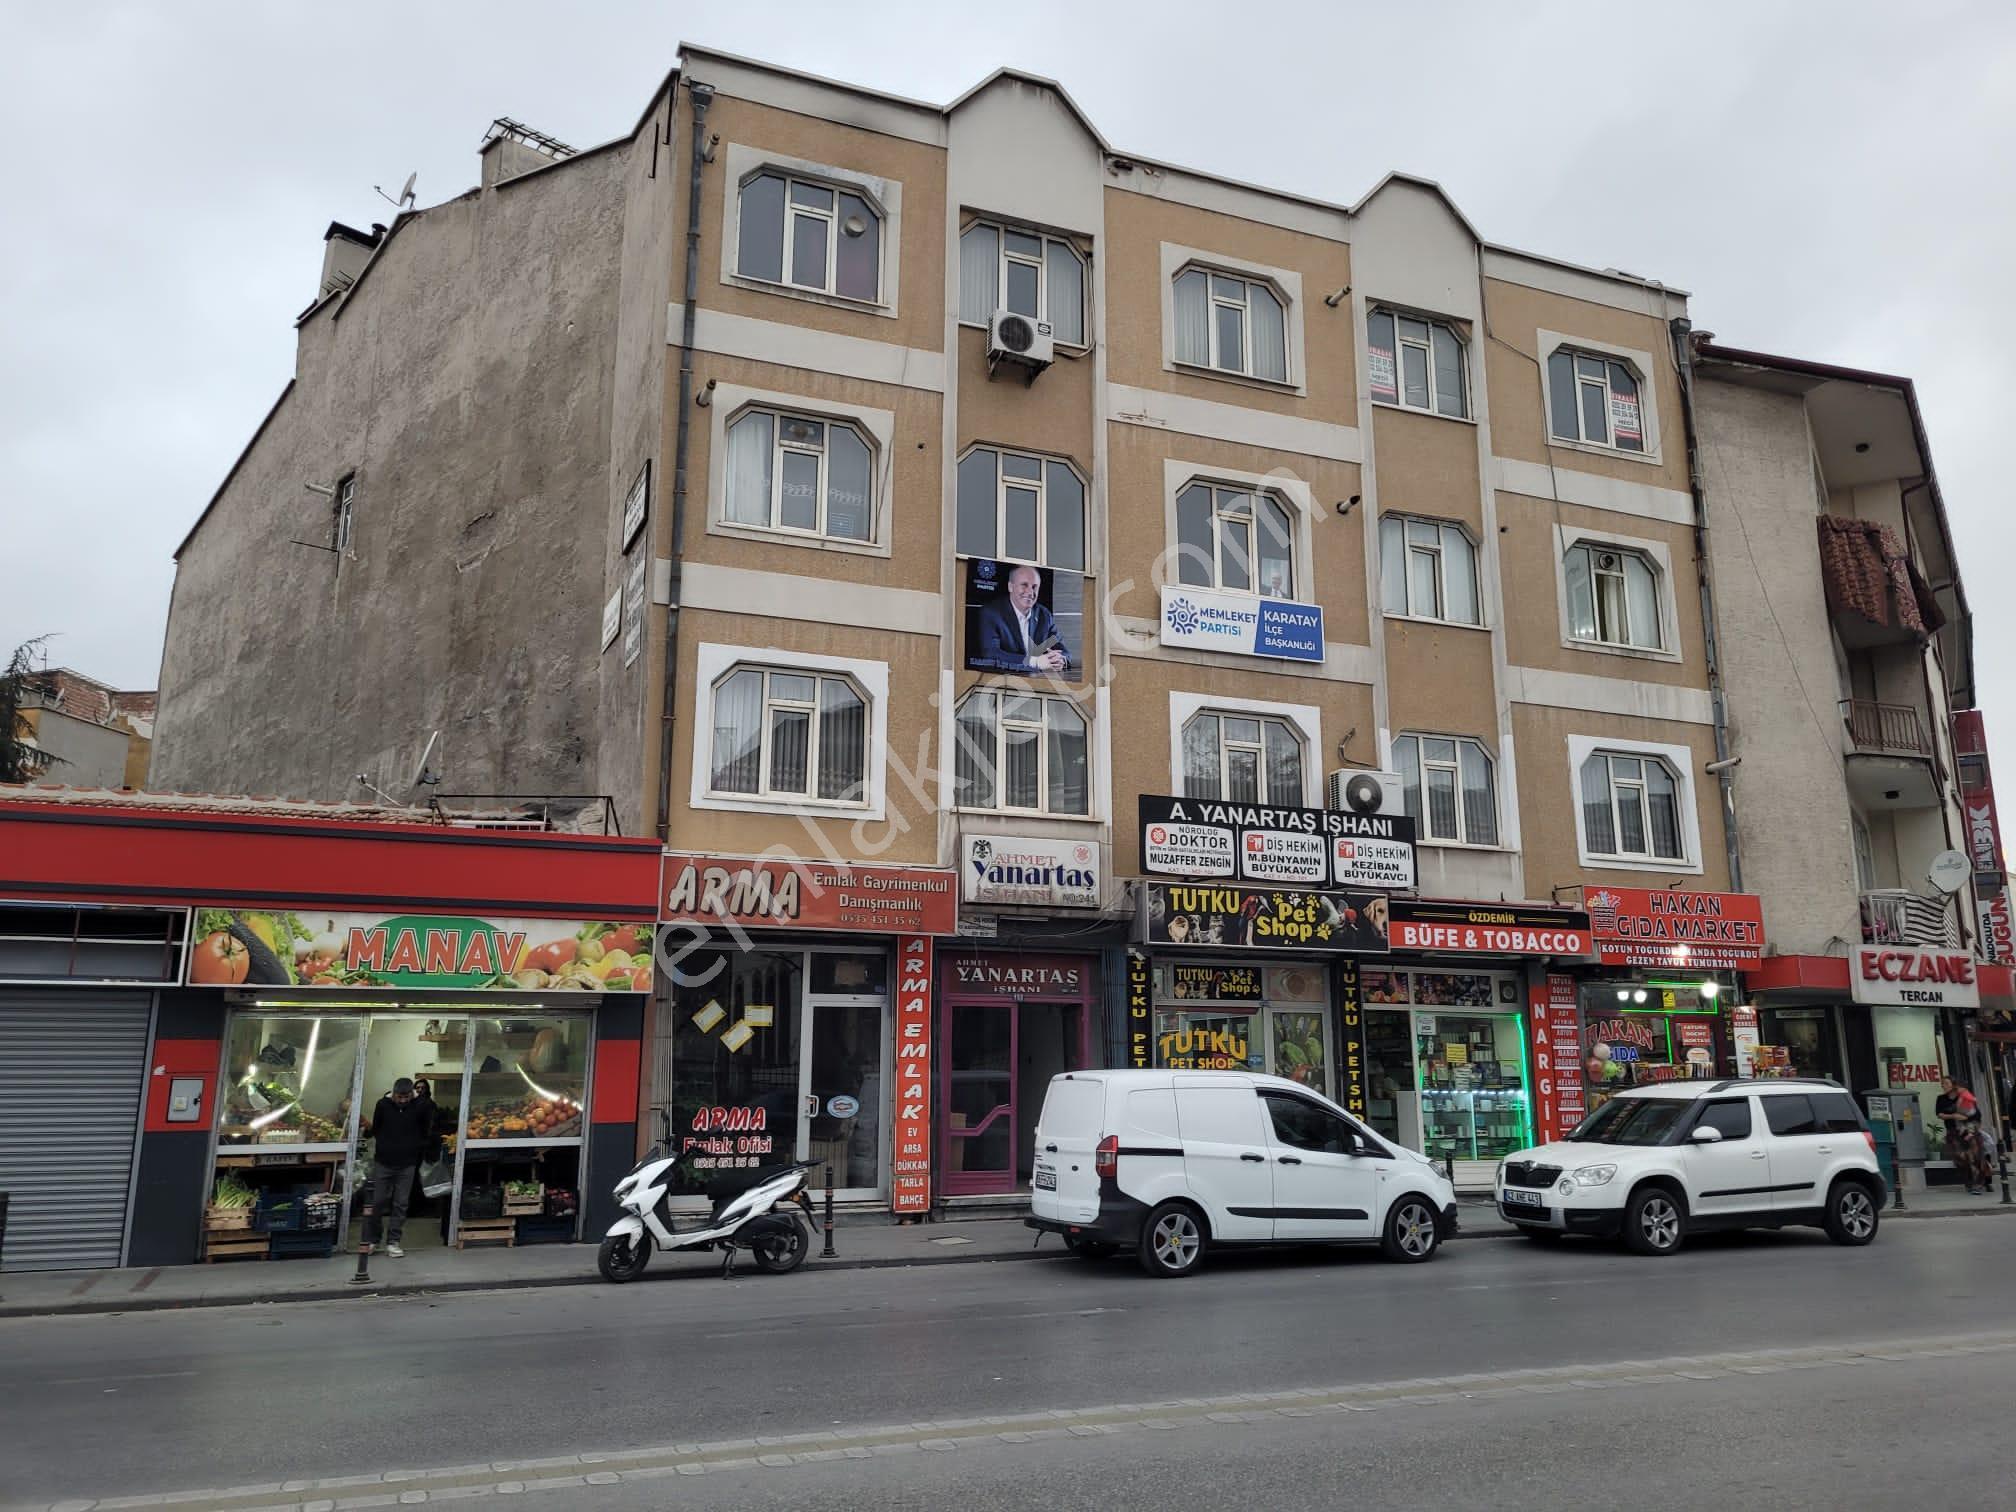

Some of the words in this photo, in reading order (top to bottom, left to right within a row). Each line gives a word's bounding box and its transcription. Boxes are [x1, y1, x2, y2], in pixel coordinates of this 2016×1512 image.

[1200, 608, 1257, 624] MEMLEKET
[1264, 611, 1318, 628] KARATAY
[1265, 623, 1284, 635] İLÇE
[1265, 637, 1316, 651] BAŞKANLIĞI
[1169, 802, 1192, 821] A.
[1200, 804, 1317, 834] YANARTAŞ
[1322, 810, 1393, 837] İŞHANI
[1178, 826, 1218, 836] NÖROLOG
[1169, 834, 1228, 849] DOKTOR
[1267, 838, 1283, 852] DİŞ
[1286, 839, 1322, 854] HEKİMİ
[994, 853, 1057, 866] AHMET
[1150, 853, 1197, 866] MUZAFFER
[1199, 856, 1231, 868] ZENGİN
[1248, 853, 1321, 866] M.BÜNYAMİN
[1357, 844, 1373, 859] DİŞ
[1376, 845, 1410, 861] HEKİMİ
[1251, 863, 1318, 876] BÜYÜKAVCI
[1351, 860, 1400, 871] KEZİBAN
[813, 872, 857, 888] Emlak
[863, 876, 948, 893] Gayrimenkul
[971, 860, 1095, 890] Yanartaş
[1344, 869, 1408, 881] BÜYÜKAVCI
[668, 864, 800, 917] ARMA
[839, 894, 922, 913] Danışmanlık
[1169, 887, 1240, 914] TUTKU
[1649, 893, 1722, 917] HAKAN
[1278, 903, 1317, 922] Pet
[1468, 909, 1516, 924] ÖZDEMİR
[1257, 915, 1313, 943] Shop
[1616, 916, 1669, 939] GIDA
[1672, 918, 1760, 943] MARKET
[1403, 923, 1458, 947] BÜFE
[1464, 930, 1478, 948] &
[1483, 930, 1580, 952] TOBACCO
[346, 926, 527, 976] MANAV
[1602, 944, 1632, 954] KOYUN
[1626, 957, 1654, 966] GEZEN
[1657, 957, 1685, 967] TAVUK
[1688, 958, 1737, 968] YUMURTASI
[1861, 951, 1975, 985] ECZANE
[901, 939, 928, 1012] ARMA
[957, 967, 1079, 986] YANARTAŞ
[1176, 968, 1213, 981] TUTKU
[1232, 974, 1253, 985] Pet
[1131, 960, 1147, 1018] TUTKU
[1221, 983, 1250, 994] Shop
[1343, 959, 1358, 1026] TUTKU
[1900, 990, 1943, 1003] TERCAN
[1585, 1019, 1655, 1051] HAKAN
[1133, 1033, 1146, 1067] PET
[1158, 1028, 1249, 1061] TUTKU
[1608, 1046, 1640, 1062] IDA
[900, 1023, 928, 1120] EMLAK
[1170, 1058, 1193, 1069] PET
[1198, 1058, 1236, 1069] SHOP
[1888, 1064, 1941, 1083] ECZANE
[692, 1106, 766, 1132] ARMA
[907, 1127, 918, 1137] EV
[737, 1136, 772, 1153] Ofisi
[903, 1143, 922, 1153] ARSA
[897, 1159, 928, 1170] DÜKKAN
[900, 1177, 924, 1188] TARLA
[899, 1194, 924, 1206] BAHÇE
